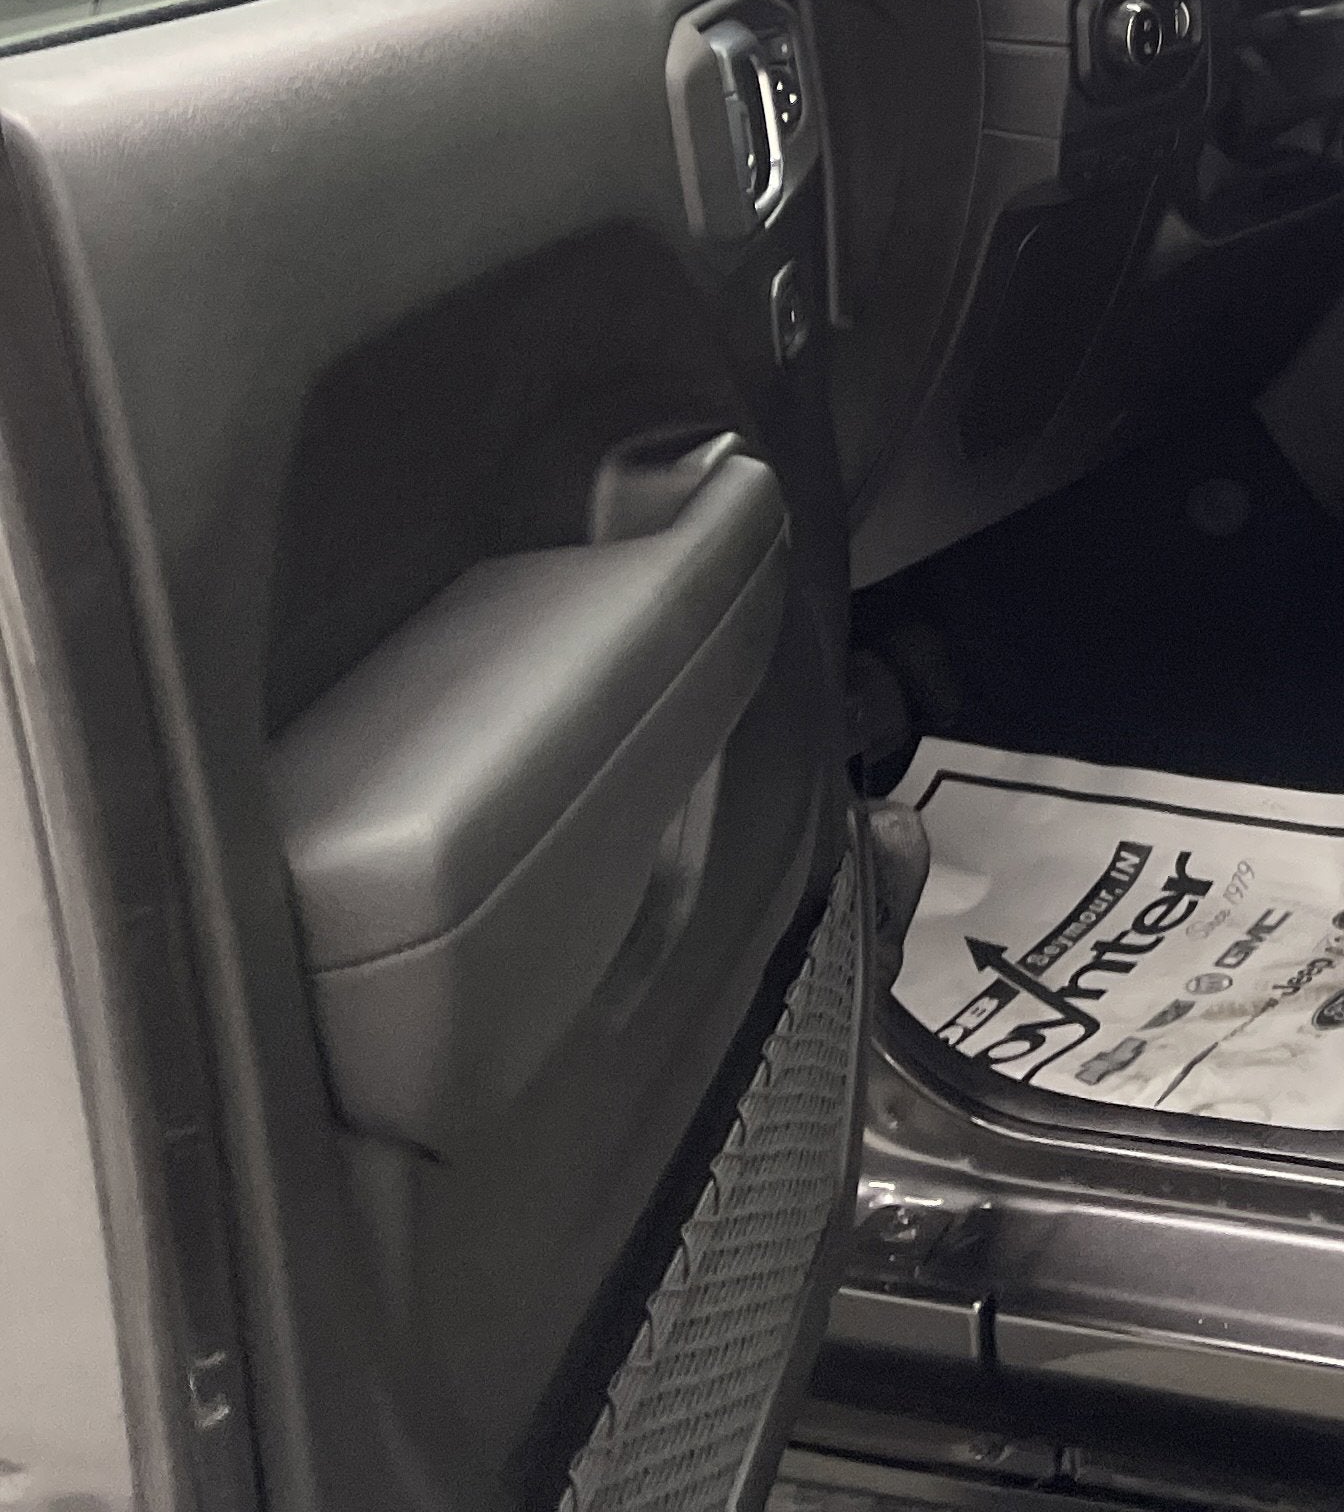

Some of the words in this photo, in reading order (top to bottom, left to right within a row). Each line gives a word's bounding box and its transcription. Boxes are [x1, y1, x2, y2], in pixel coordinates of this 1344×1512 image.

[1110, 850, 1141, 882] IN
[1223, 860, 1256, 905] 1979
[1214, 908, 1293, 969] GMC
[972, 851, 1214, 1082] oynter
[1272, 958, 1336, 997] Jeep
